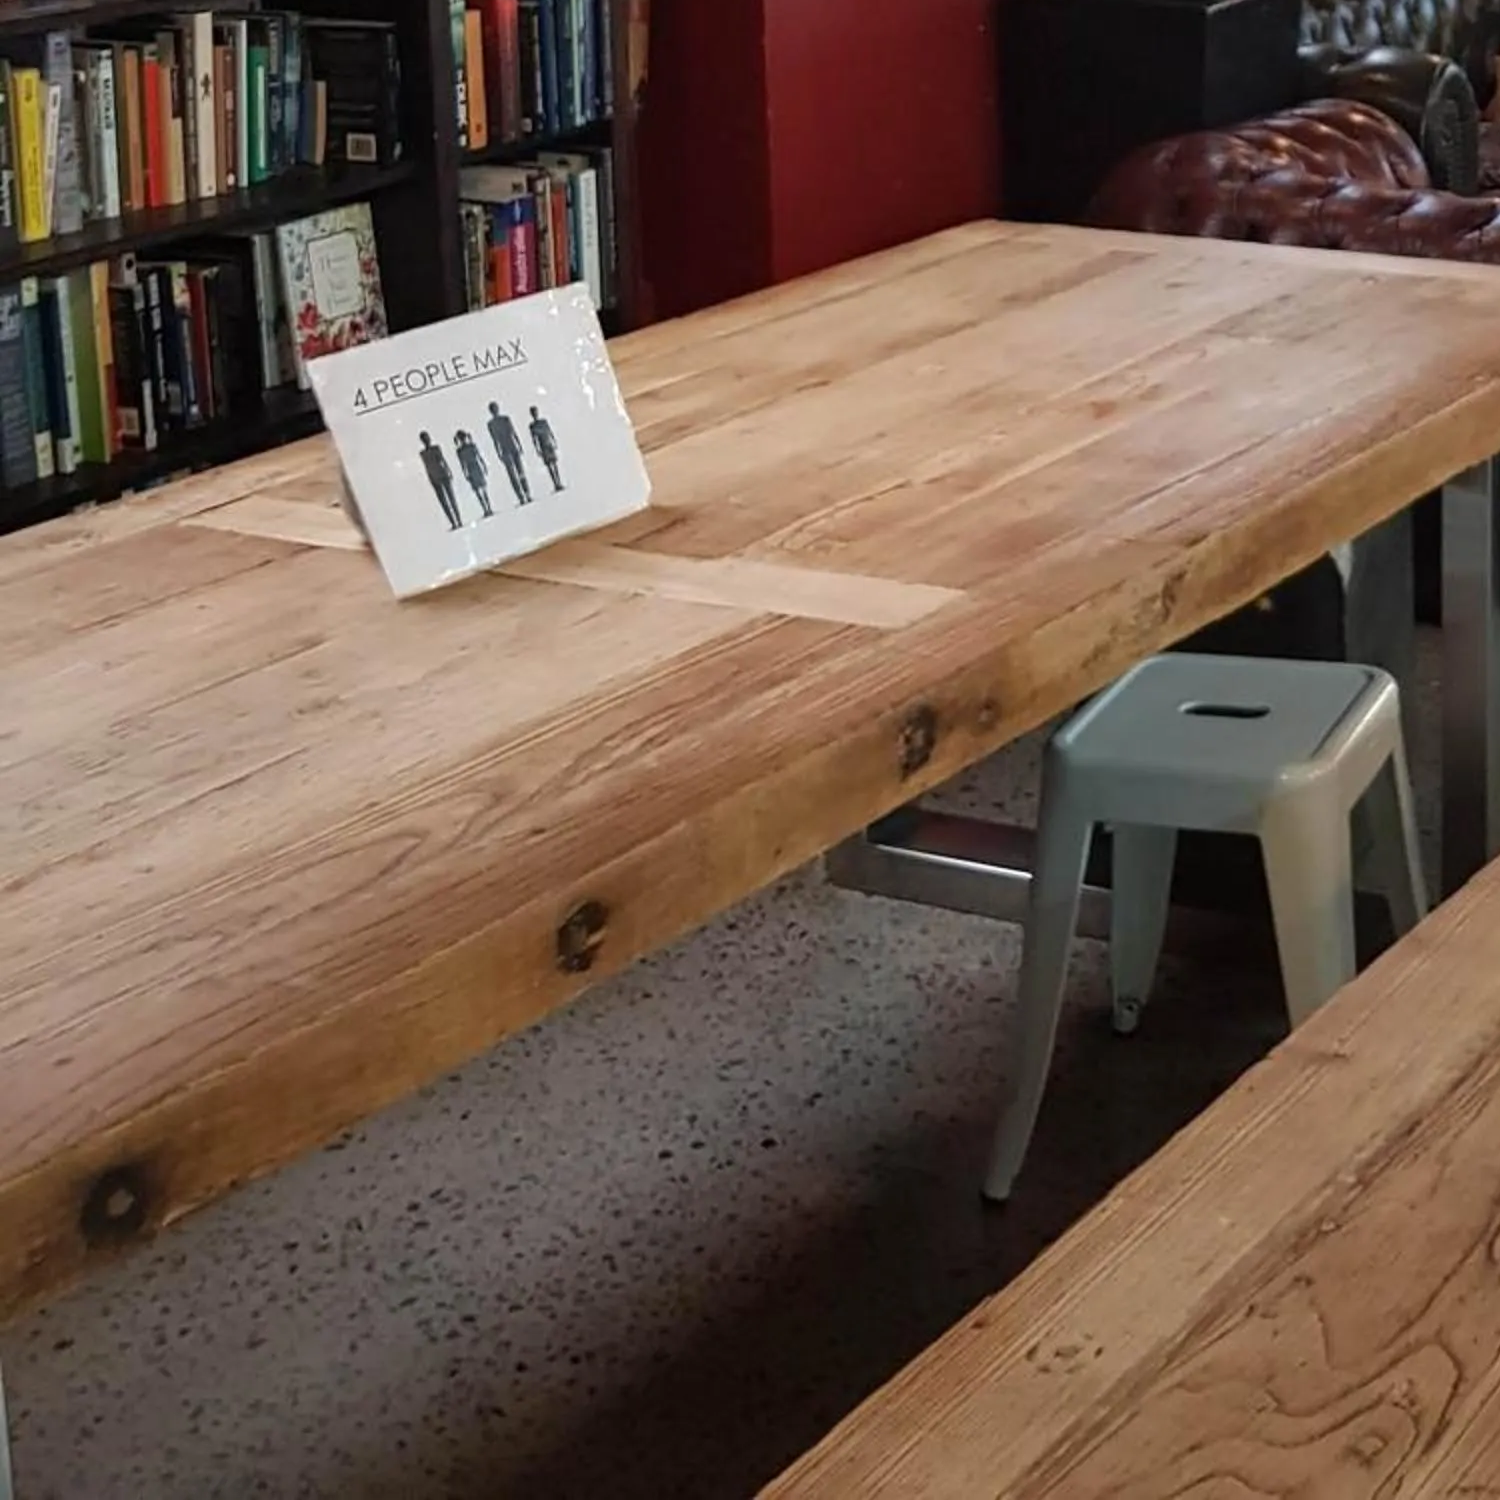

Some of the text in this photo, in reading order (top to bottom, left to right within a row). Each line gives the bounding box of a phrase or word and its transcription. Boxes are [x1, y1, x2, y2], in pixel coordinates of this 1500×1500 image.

[353, 338, 527, 409] 4 PEOPLE MAX
